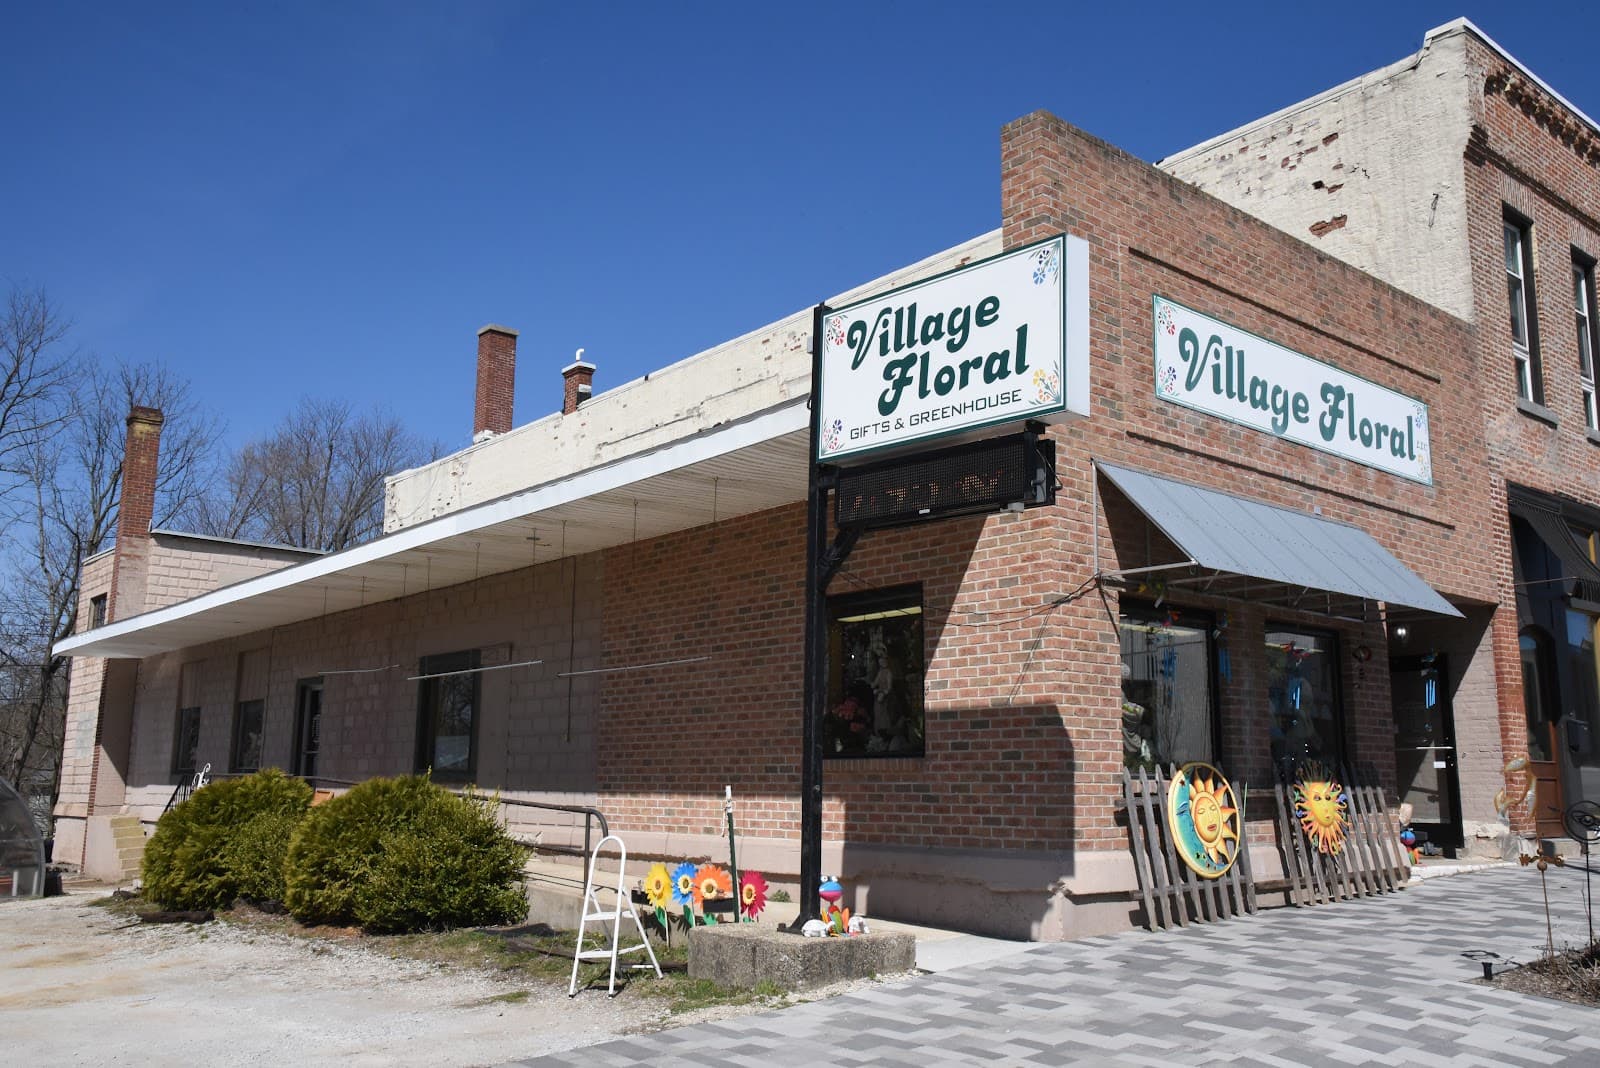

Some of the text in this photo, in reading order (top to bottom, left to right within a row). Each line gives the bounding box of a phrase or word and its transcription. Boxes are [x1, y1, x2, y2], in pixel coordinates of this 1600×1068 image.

[846, 295, 1001, 371] Village
[877, 323, 1030, 417] Floral
[849, 388, 1023, 441] GIFTS & GREENHOUSE
[1178, 327, 1416, 462] Village Floral
